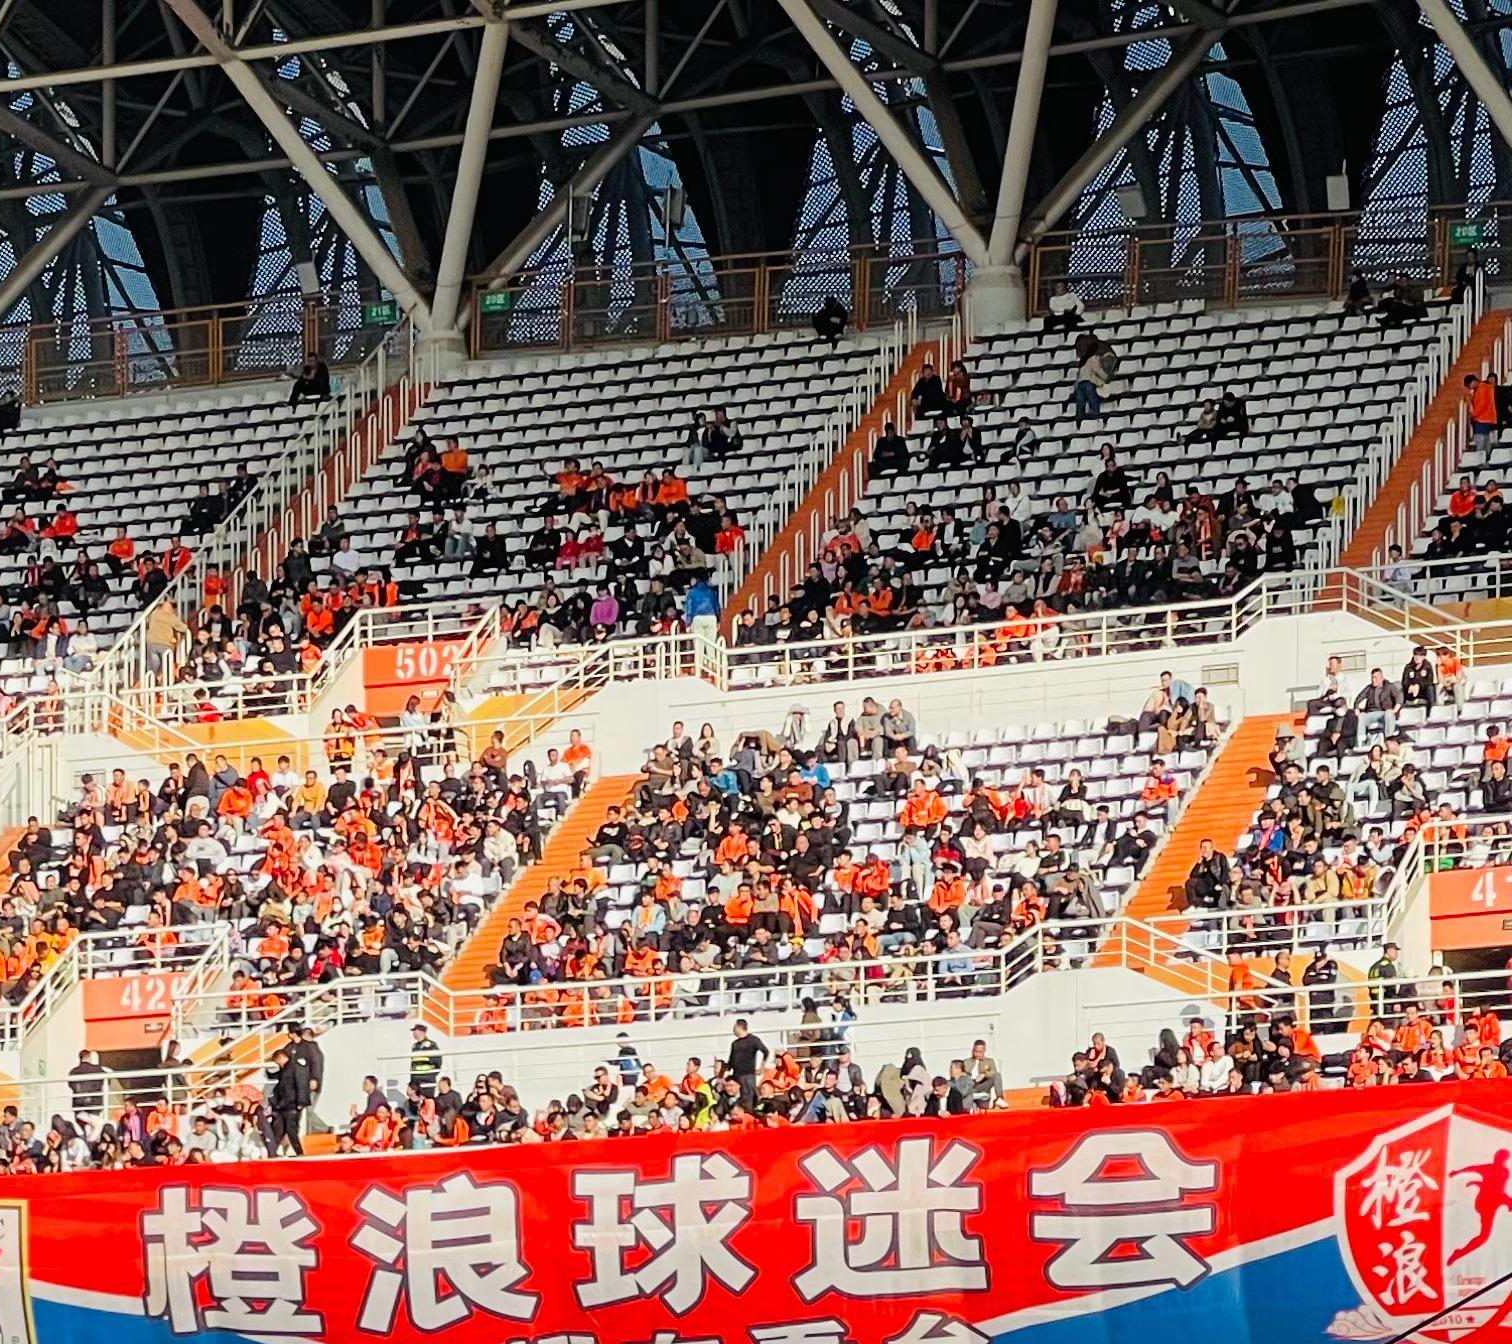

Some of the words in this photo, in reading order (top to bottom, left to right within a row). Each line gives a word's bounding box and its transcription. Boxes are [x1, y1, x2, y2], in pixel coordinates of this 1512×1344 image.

[143, 1129, 1219, 1335] 橙浪球迷会
